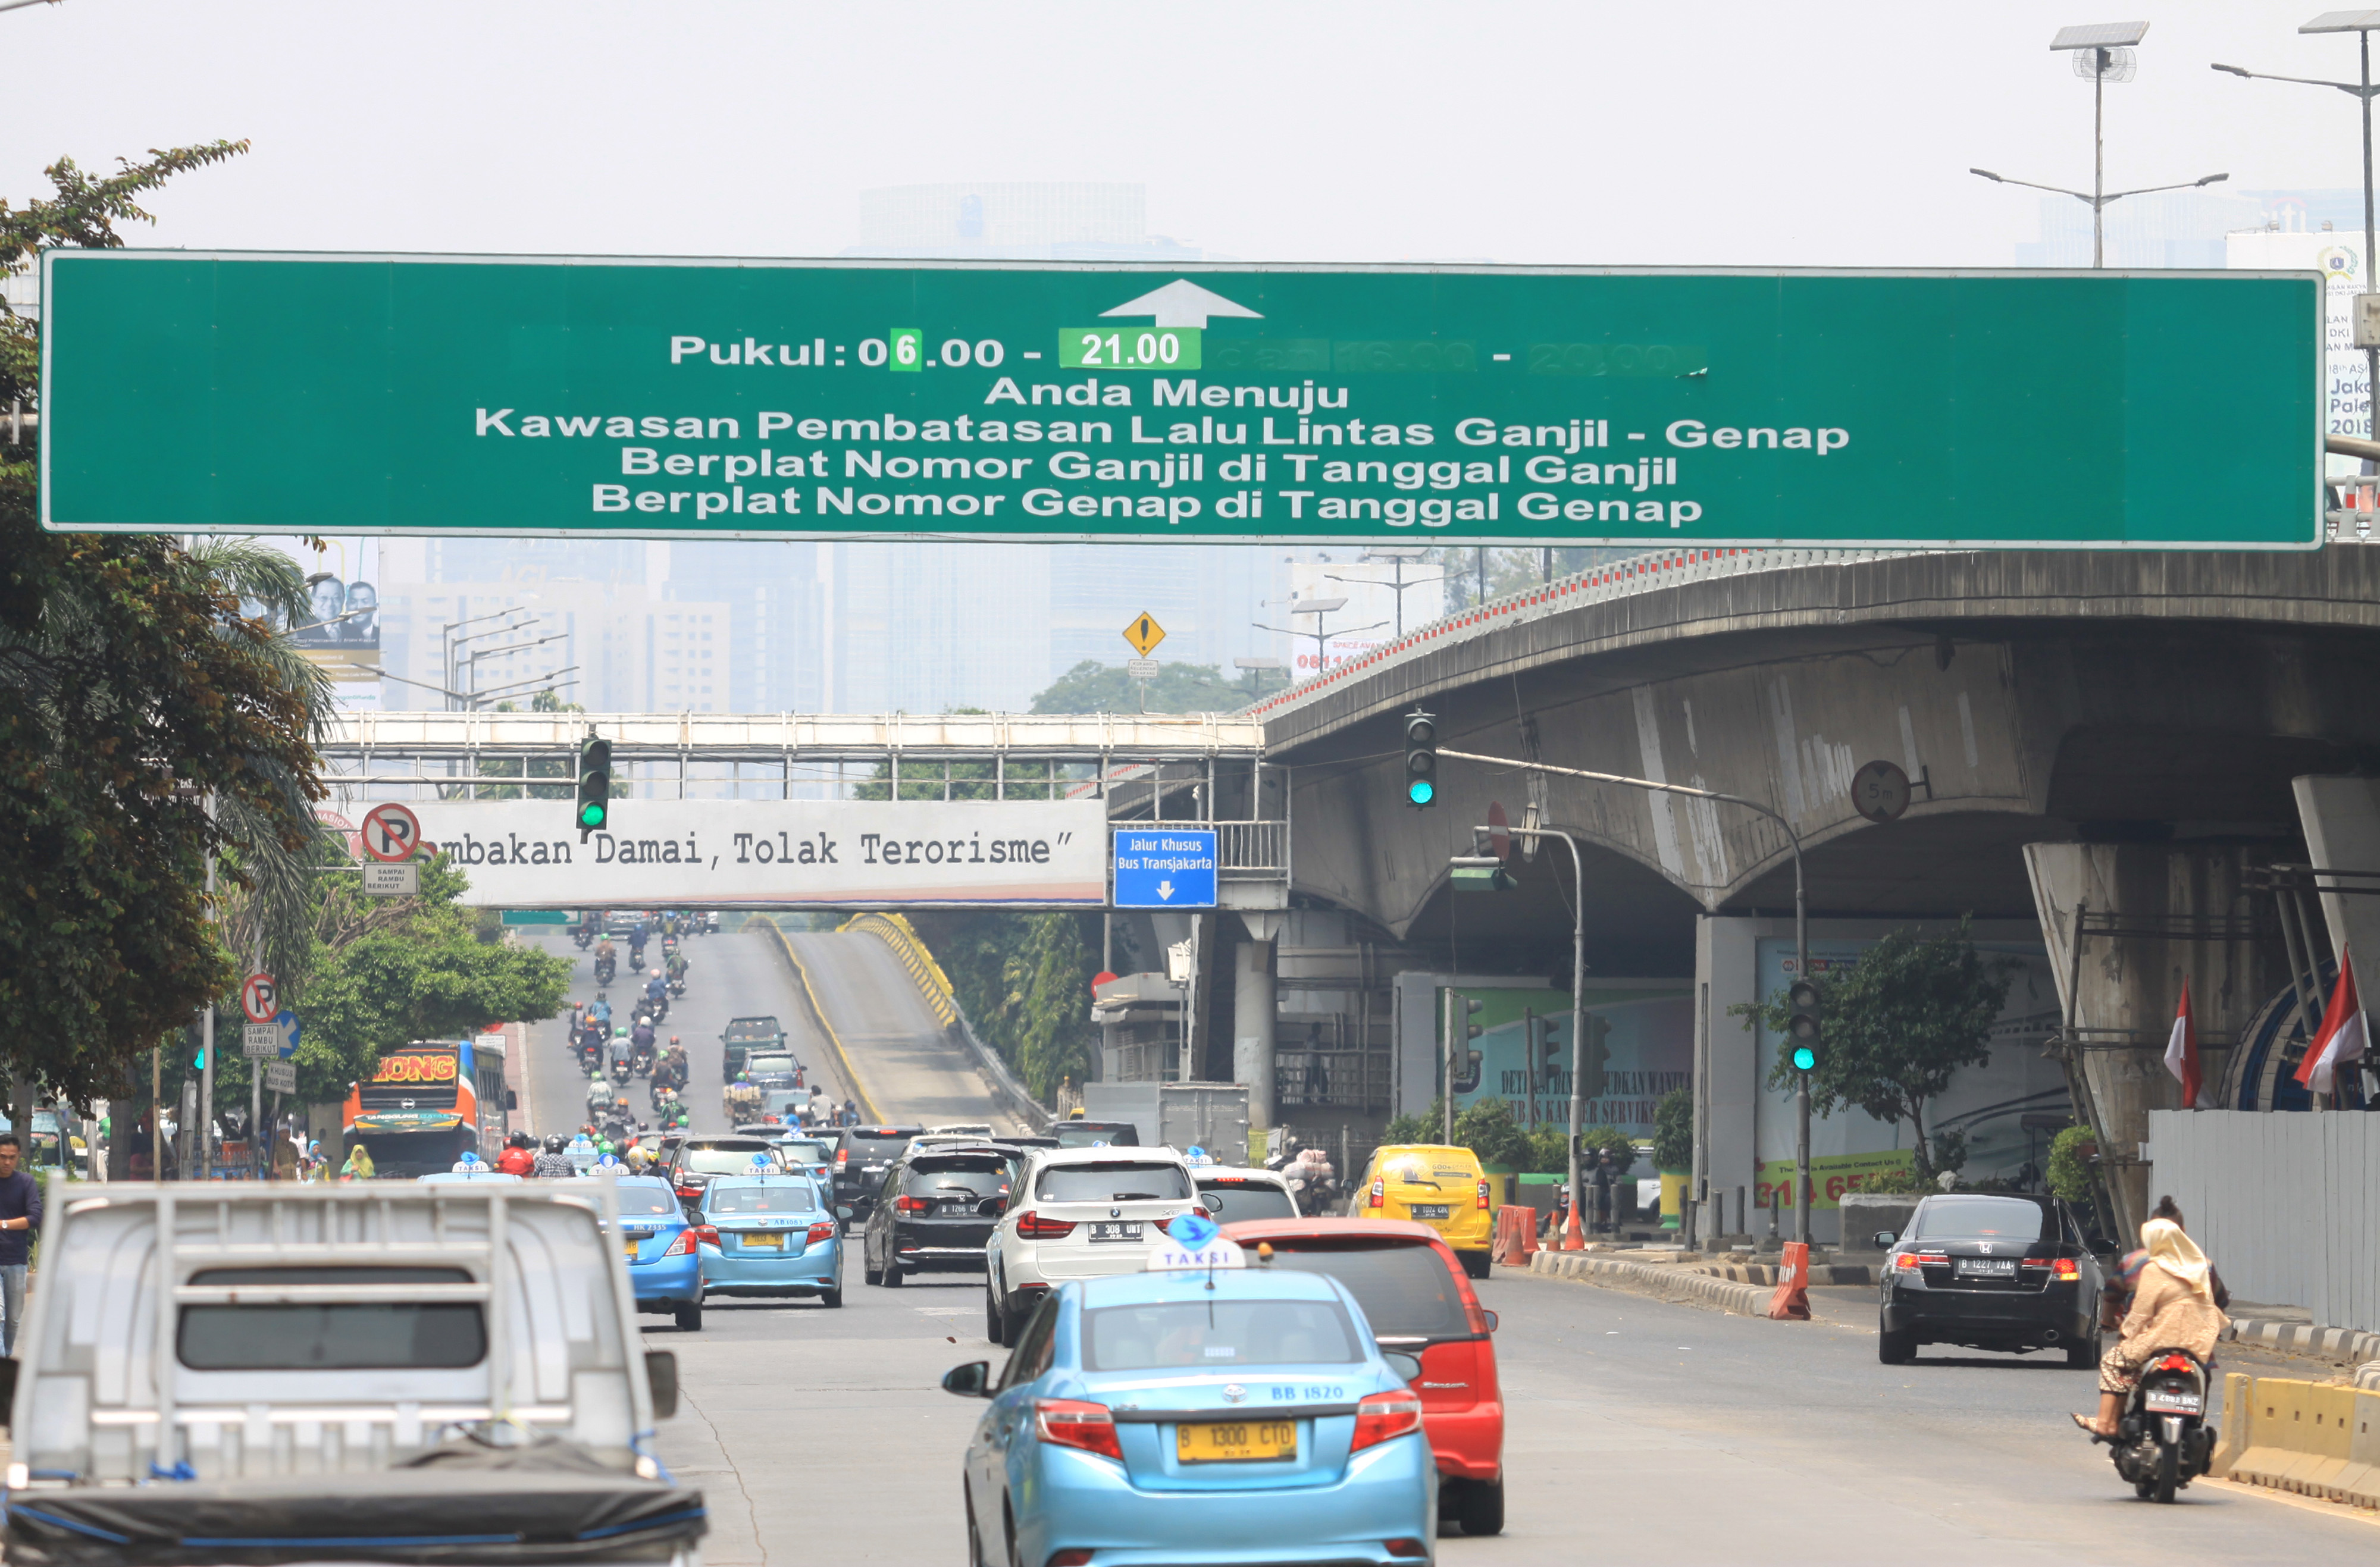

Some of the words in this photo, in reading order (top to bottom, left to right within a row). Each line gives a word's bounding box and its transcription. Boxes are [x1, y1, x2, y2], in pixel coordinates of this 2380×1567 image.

[2330, 328, 2349, 337] DKI
[1081, 331, 1180, 366] 21.00
[984, 377, 1132, 406] Anda
[1153, 378, 1348, 415] Menuju
[476, 408, 739, 439] Kawasan
[759, 411, 1112, 443] Pembatasan
[1132, 415, 1247, 444] Lalu
[1263, 417, 1435, 446] Lintas
[1455, 418, 1608, 455] Ganjil
[1665, 419, 1849, 456] Genap
[2331, 419, 2372, 435] 2018
[622, 447, 829, 483] Berplat
[845, 450, 1034, 479] Nomor
[1048, 451, 1203, 488] Ganjil
[1219, 453, 1266, 482] di
[1283, 454, 1510, 490] Tanggal
[1525, 455, 1676, 492] Ganjil
[593, 484, 801, 520] Berplat
[817, 486, 1006, 516] Nomor
[1022, 488, 1201, 525] Genap
[1215, 490, 1262, 518] di
[1279, 490, 1499, 527] Tanggal
[1517, 492, 1702, 528] Genap
[430, 832, 572, 865] mbakan
[596, 831, 719, 870] Damai,
[734, 832, 838, 864] Tolak
[1130, 838, 1158, 851] Jalur
[1161, 838, 1202, 851] Khusus
[1119, 857, 1139, 869] Bus
[1142, 857, 1212, 873] Transjakarta
[248, 1027, 274, 1035] SAMPAI
[248, 1036, 273, 1045] RAMBU
[246, 1045, 276, 1054] BERIKUT
[270, 1066, 293, 1077] KHUSUS
[268, 1076, 279, 1086] BUS
[280, 1079, 295, 1089] KOTA
[1819, 1163, 1852, 1171] Available
[1091, 1225, 1097, 1234] B
[1106, 1224, 1120, 1234] 308
[1164, 1251, 1229, 1265] TAKSI
[1962, 1259, 1967, 1268] B
[1973, 1260, 1990, 1269] 1227
[1272, 1387, 1296, 1400] BB
[1304, 1386, 1344, 1399] 1820
[2150, 1393, 2156, 1402] B
[1181, 1428, 1190, 1448] B
[1211, 1425, 1248, 1447] 1300
